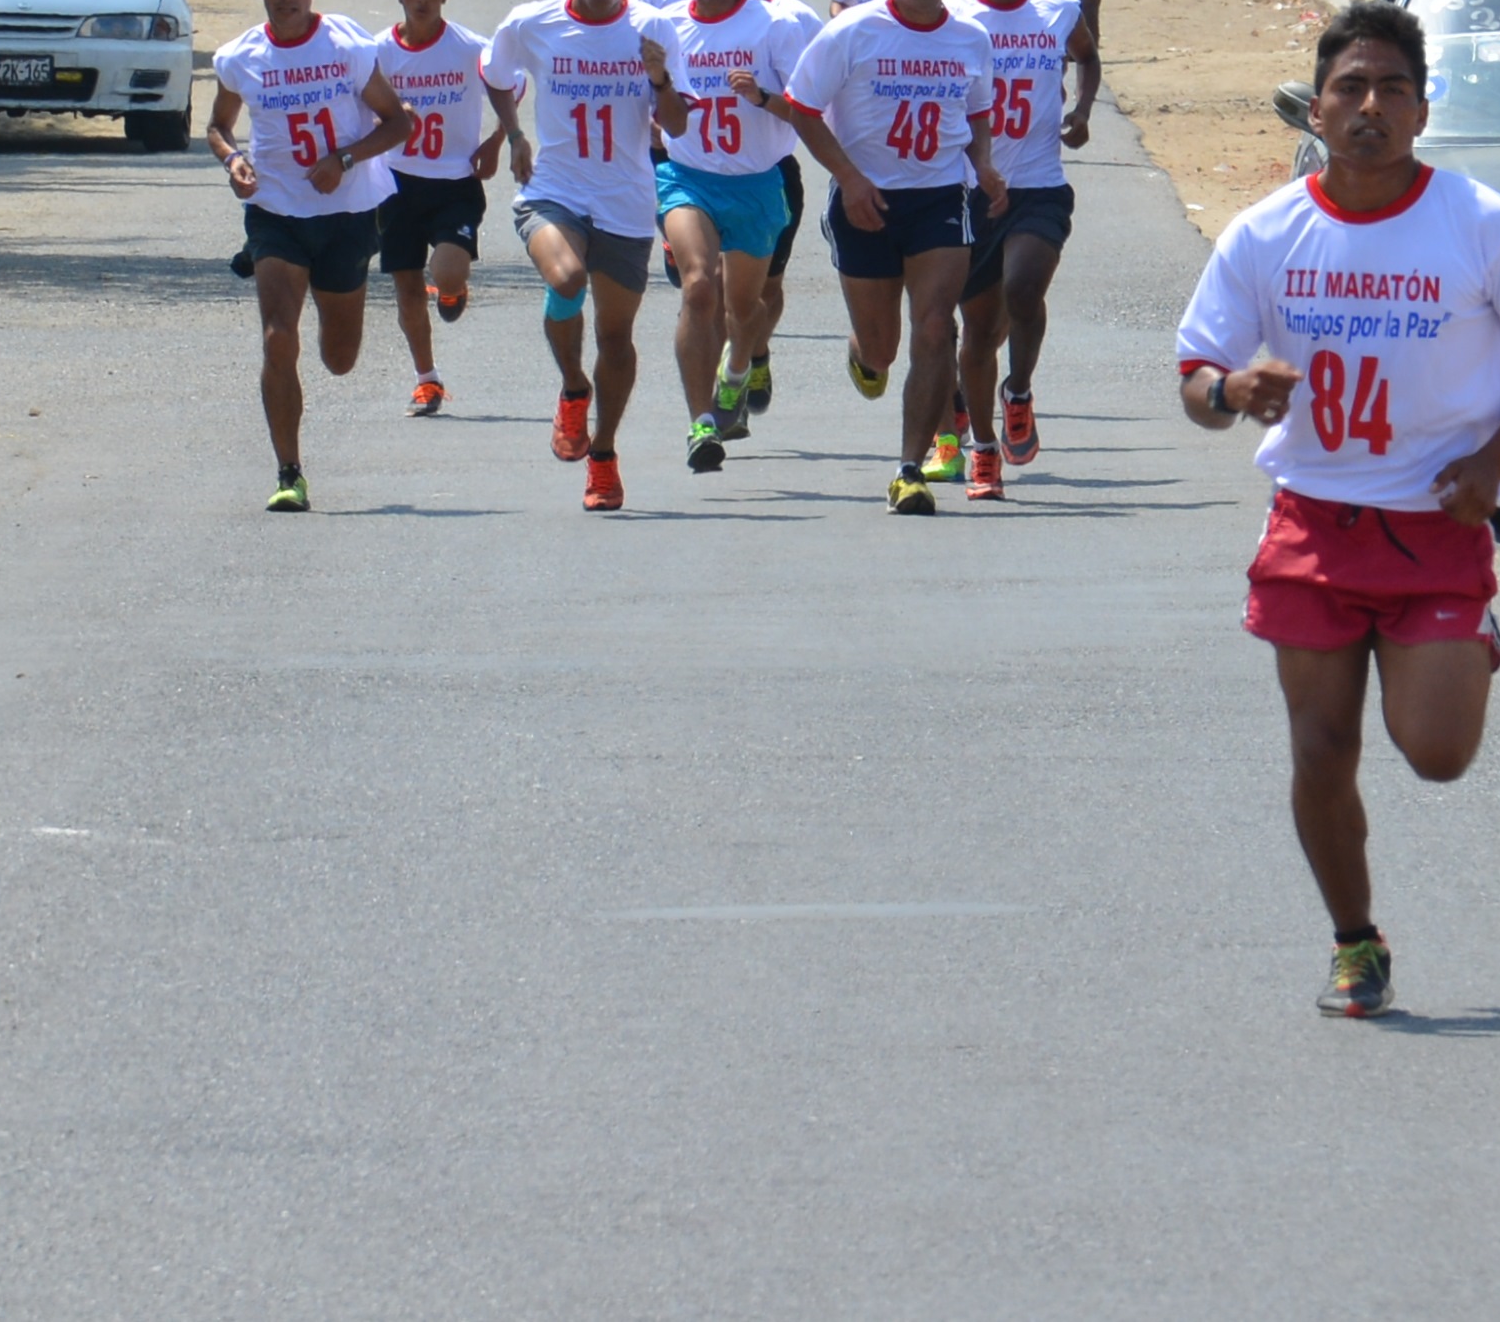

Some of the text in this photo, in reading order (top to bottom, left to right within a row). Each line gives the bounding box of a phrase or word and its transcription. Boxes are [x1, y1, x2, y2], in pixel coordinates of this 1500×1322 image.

[552, 56, 572, 74] III
[688, 46, 753, 67] MARATÓN
[877, 58, 966, 77] III MARATÓN
[1003, 55, 1023, 73] por
[262, 59, 349, 89] III MARATÓN
[407, 69, 464, 90] MARATÓN
[704, 76, 721, 93] por
[257, 89, 301, 110] "Amigos
[304, 88, 321, 107] por
[323, 86, 333, 99] la
[420, 93, 436, 108] por
[438, 91, 447, 104] la
[592, 83, 612, 100] por
[615, 81, 625, 96] la
[870, 80, 912, 100] "Amigos
[914, 82, 934, 99] por
[936, 81, 945, 97] la
[287, 107, 337, 167] 51
[402, 112, 444, 160] 26
[570, 103, 612, 162] 11
[699, 96, 741, 155] 75
[886, 100, 941, 161] 48
[1285, 269, 1441, 303] III MARATÓN
[1277, 305, 1454, 343] "Amigos por la Paz"
[1309, 349, 1393, 455] 84
